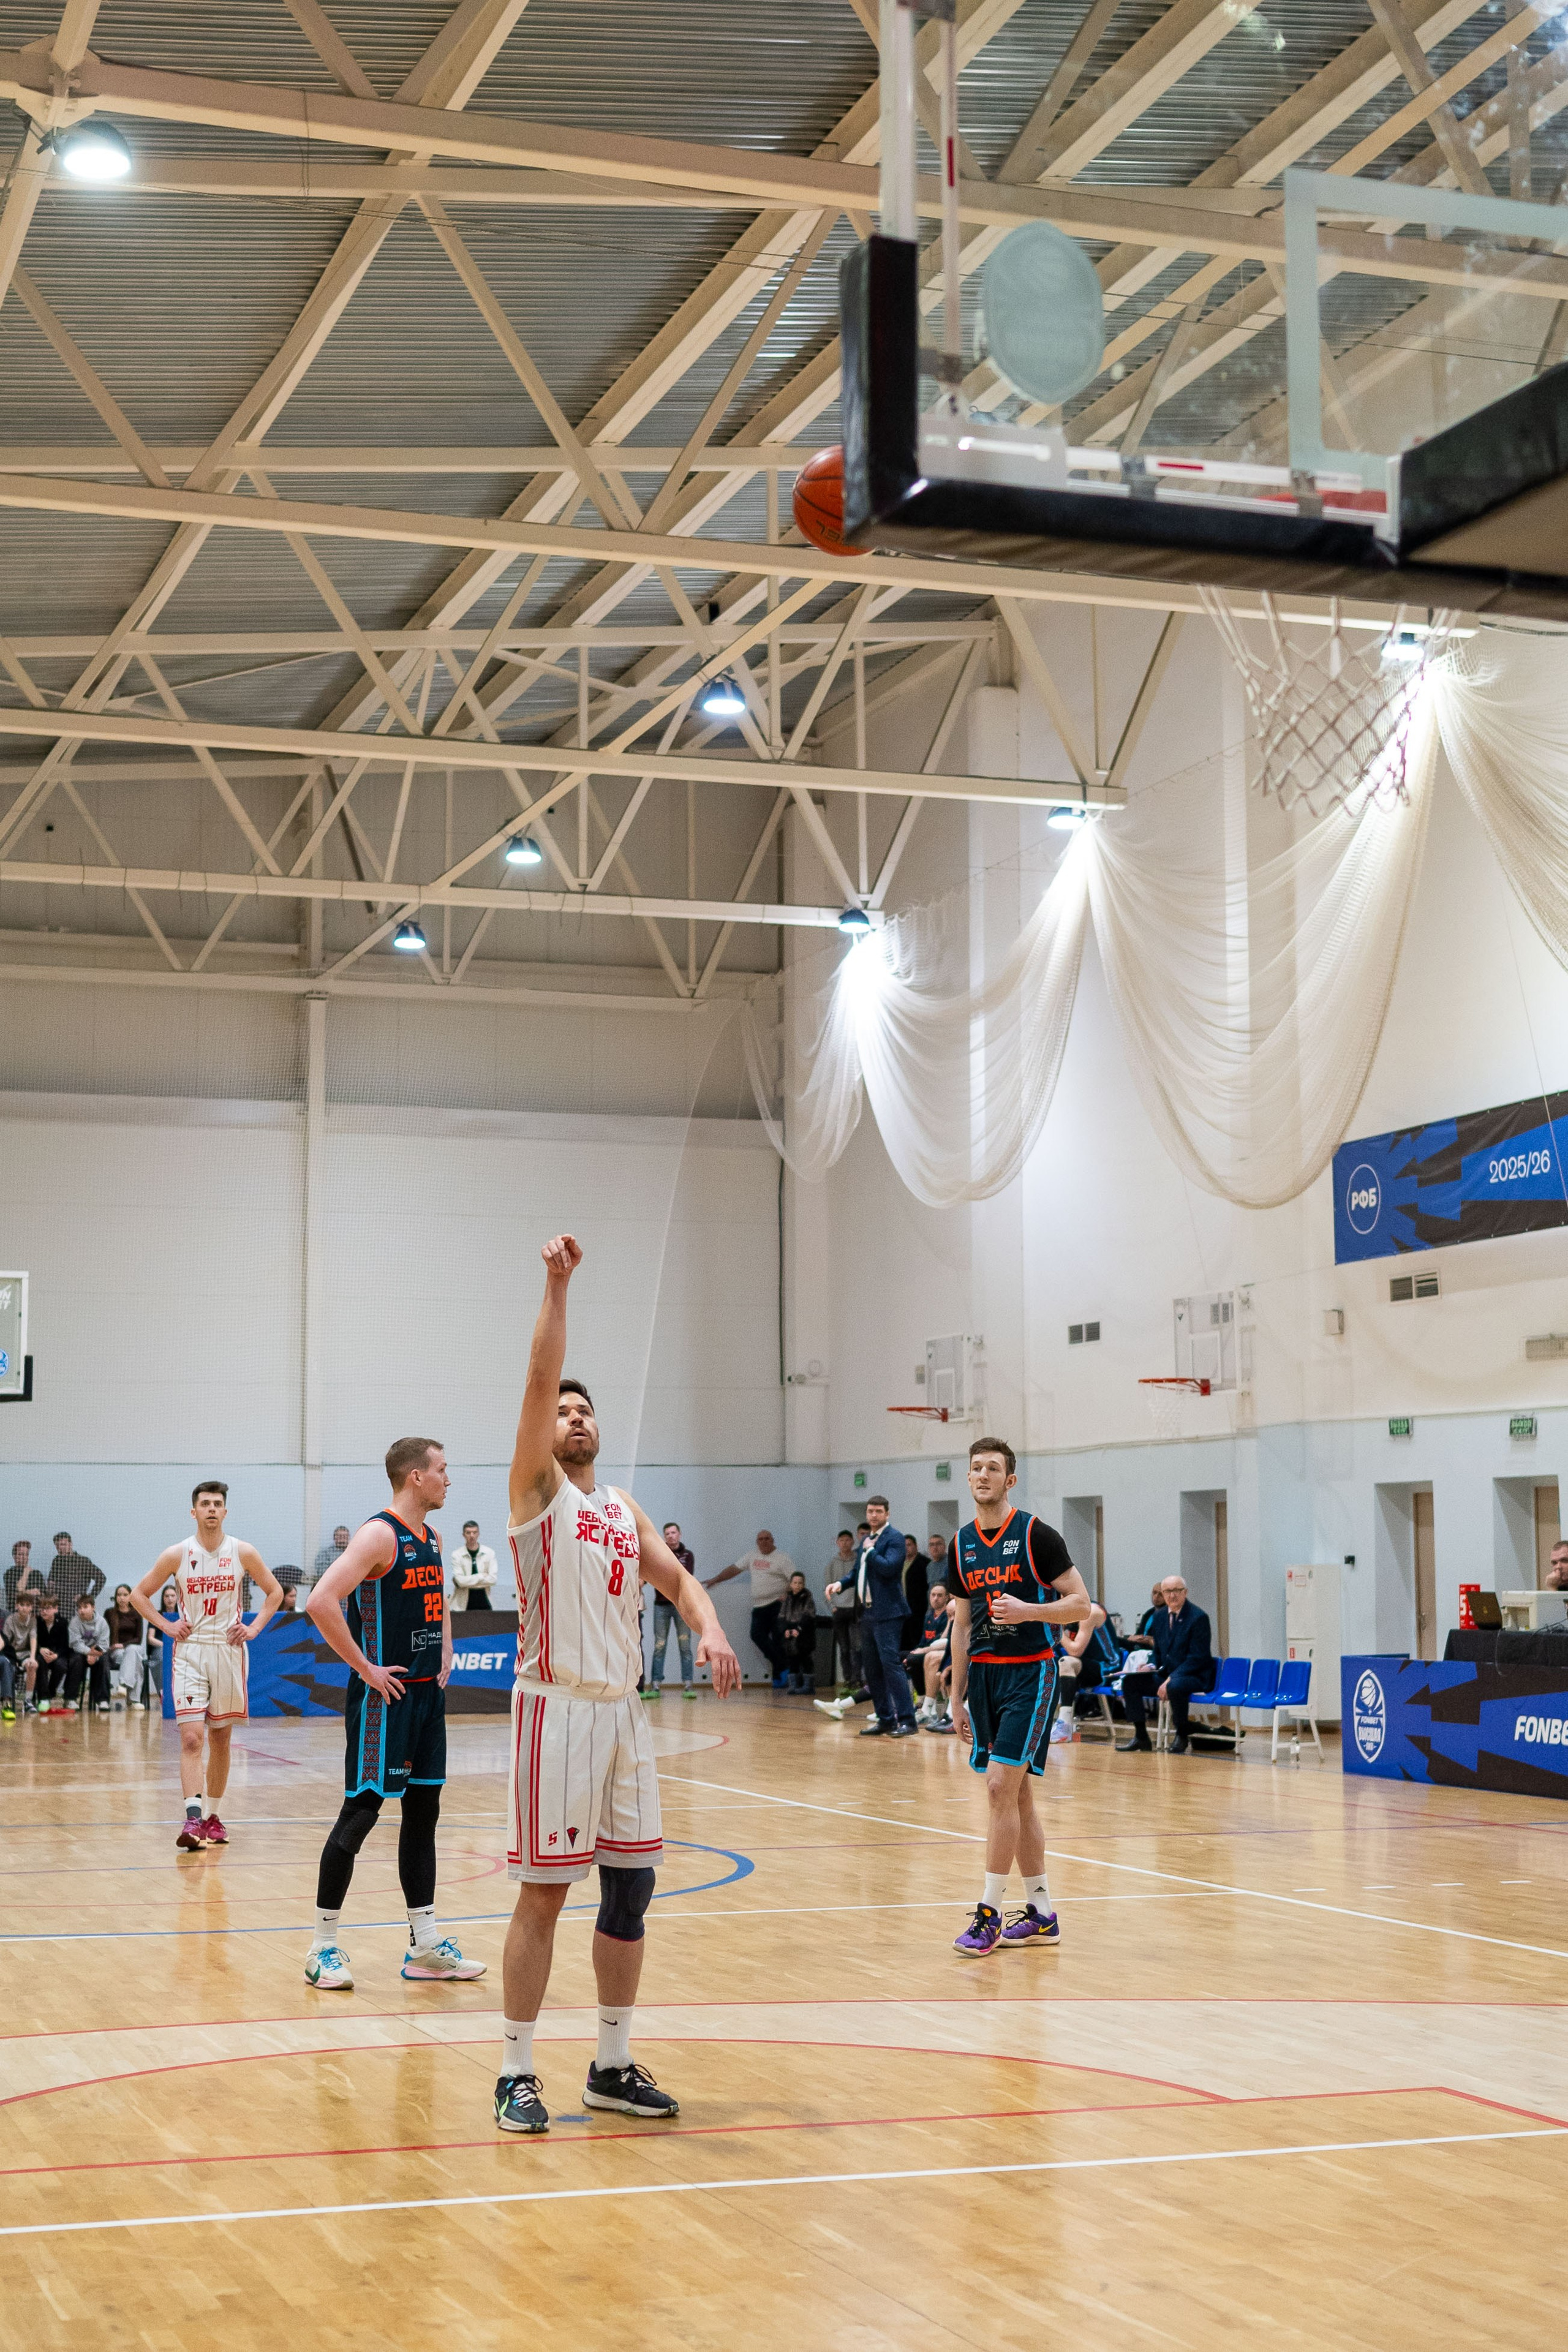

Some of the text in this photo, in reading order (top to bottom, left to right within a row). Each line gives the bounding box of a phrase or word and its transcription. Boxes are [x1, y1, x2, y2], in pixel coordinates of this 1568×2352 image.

[1489, 1149, 1551, 1184] 2025/26
[1351, 1187, 1377, 1211] РФБ
[606, 1511, 622, 1520] BET
[1002, 1547, 1019, 1555] BET
[1003, 1539, 1020, 1548] FON
[186, 1581, 236, 1594] ЯСТРЕБЫ
[401, 1565, 443, 1589] ДЕСН
[608, 1559, 624, 1596] 8
[966, 1564, 1023, 1590] ДЕСНА
[203, 1598, 217, 1616] 10
[423, 1593, 442, 1623] 22
[450, 1653, 508, 1670] NBET
[1514, 1715, 1568, 1746] FONBE
